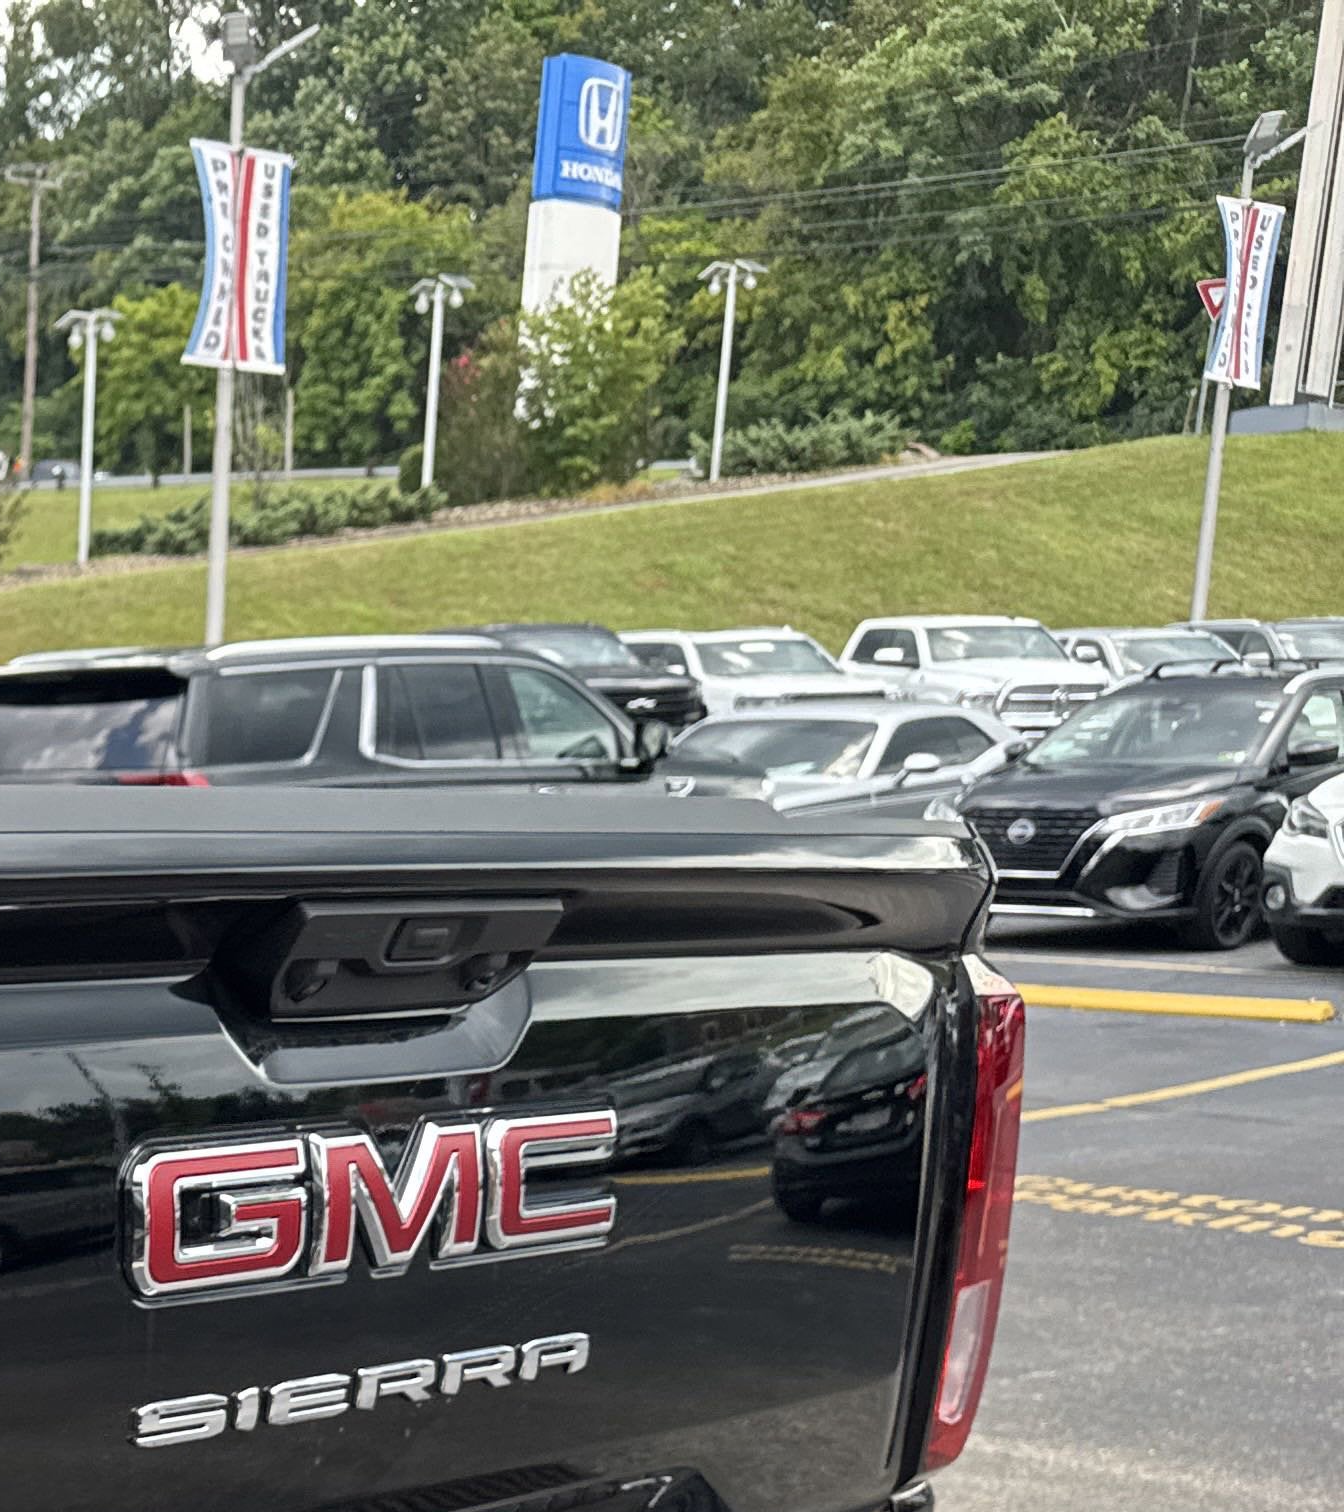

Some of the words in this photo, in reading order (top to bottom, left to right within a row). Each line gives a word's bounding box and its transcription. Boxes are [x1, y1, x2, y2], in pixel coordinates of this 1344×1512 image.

[256, 164, 276, 239] USED
[128, 1108, 617, 1300] GMC
[130, 1331, 591, 1448] SIERRA
